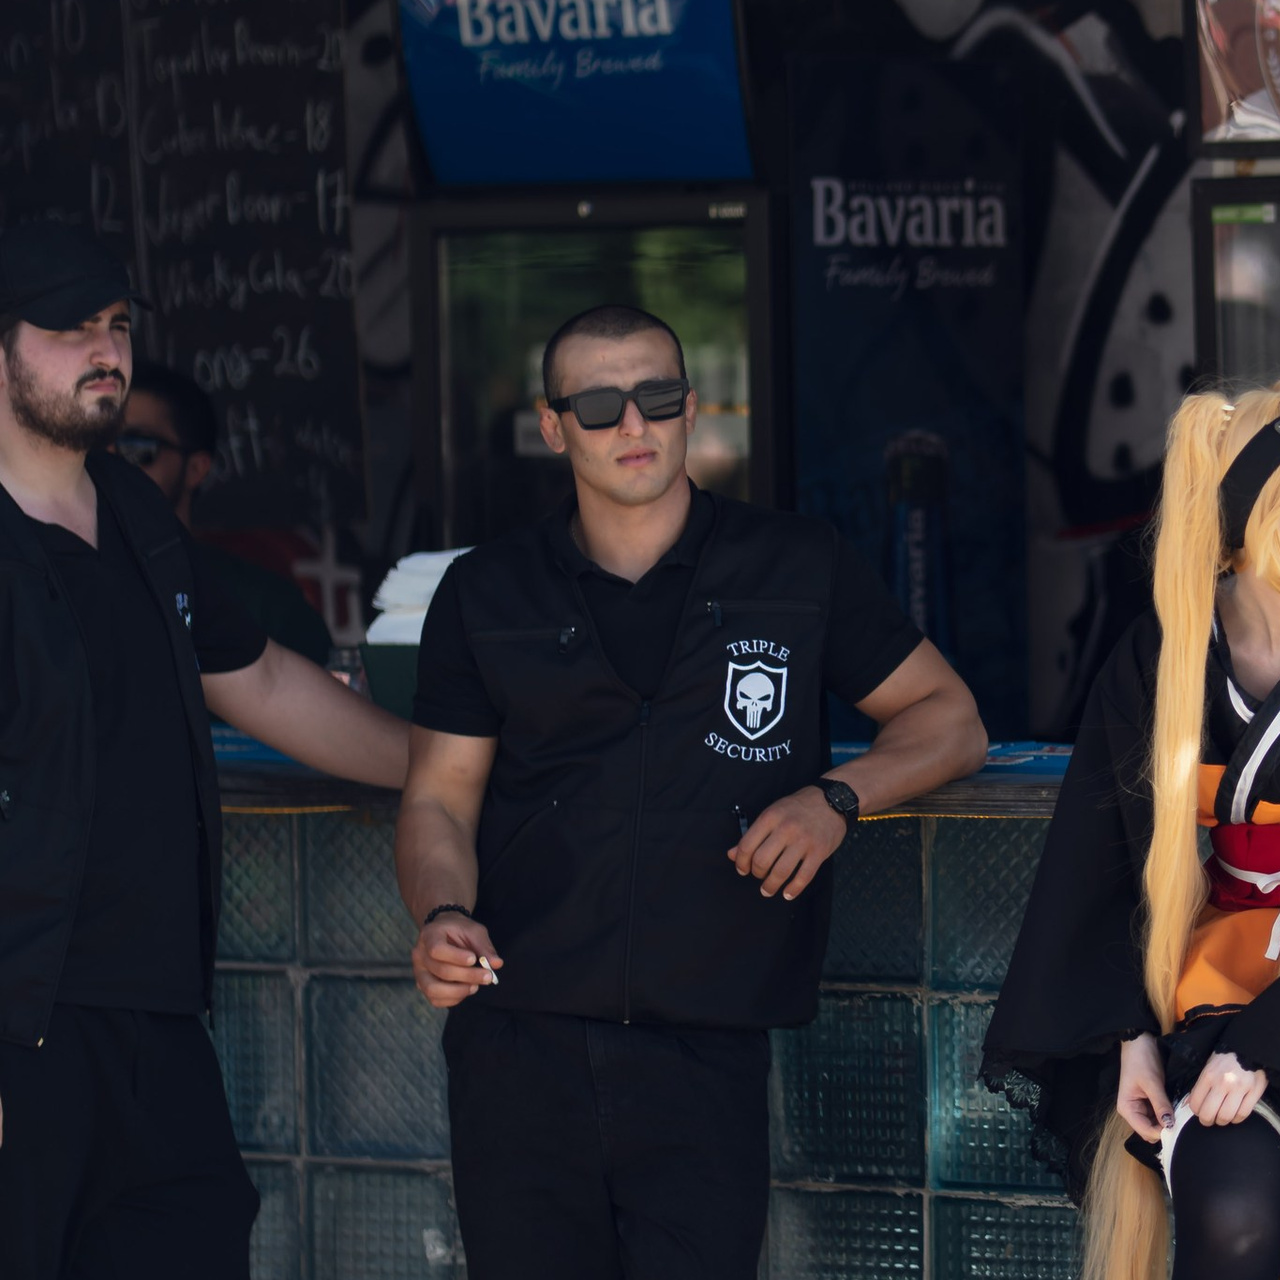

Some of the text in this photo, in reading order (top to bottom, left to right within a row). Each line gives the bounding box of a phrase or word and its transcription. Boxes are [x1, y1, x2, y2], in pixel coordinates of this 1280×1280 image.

[478, 46, 664, 91] Family Brewed
[810, 175, 1008, 248] Bavaria
[824, 252, 997, 301] Family Brewed
[902, 506, 929, 635] avaria
[726, 639, 791, 662] TRIPLE
[704, 732, 792, 763] SECURITY
